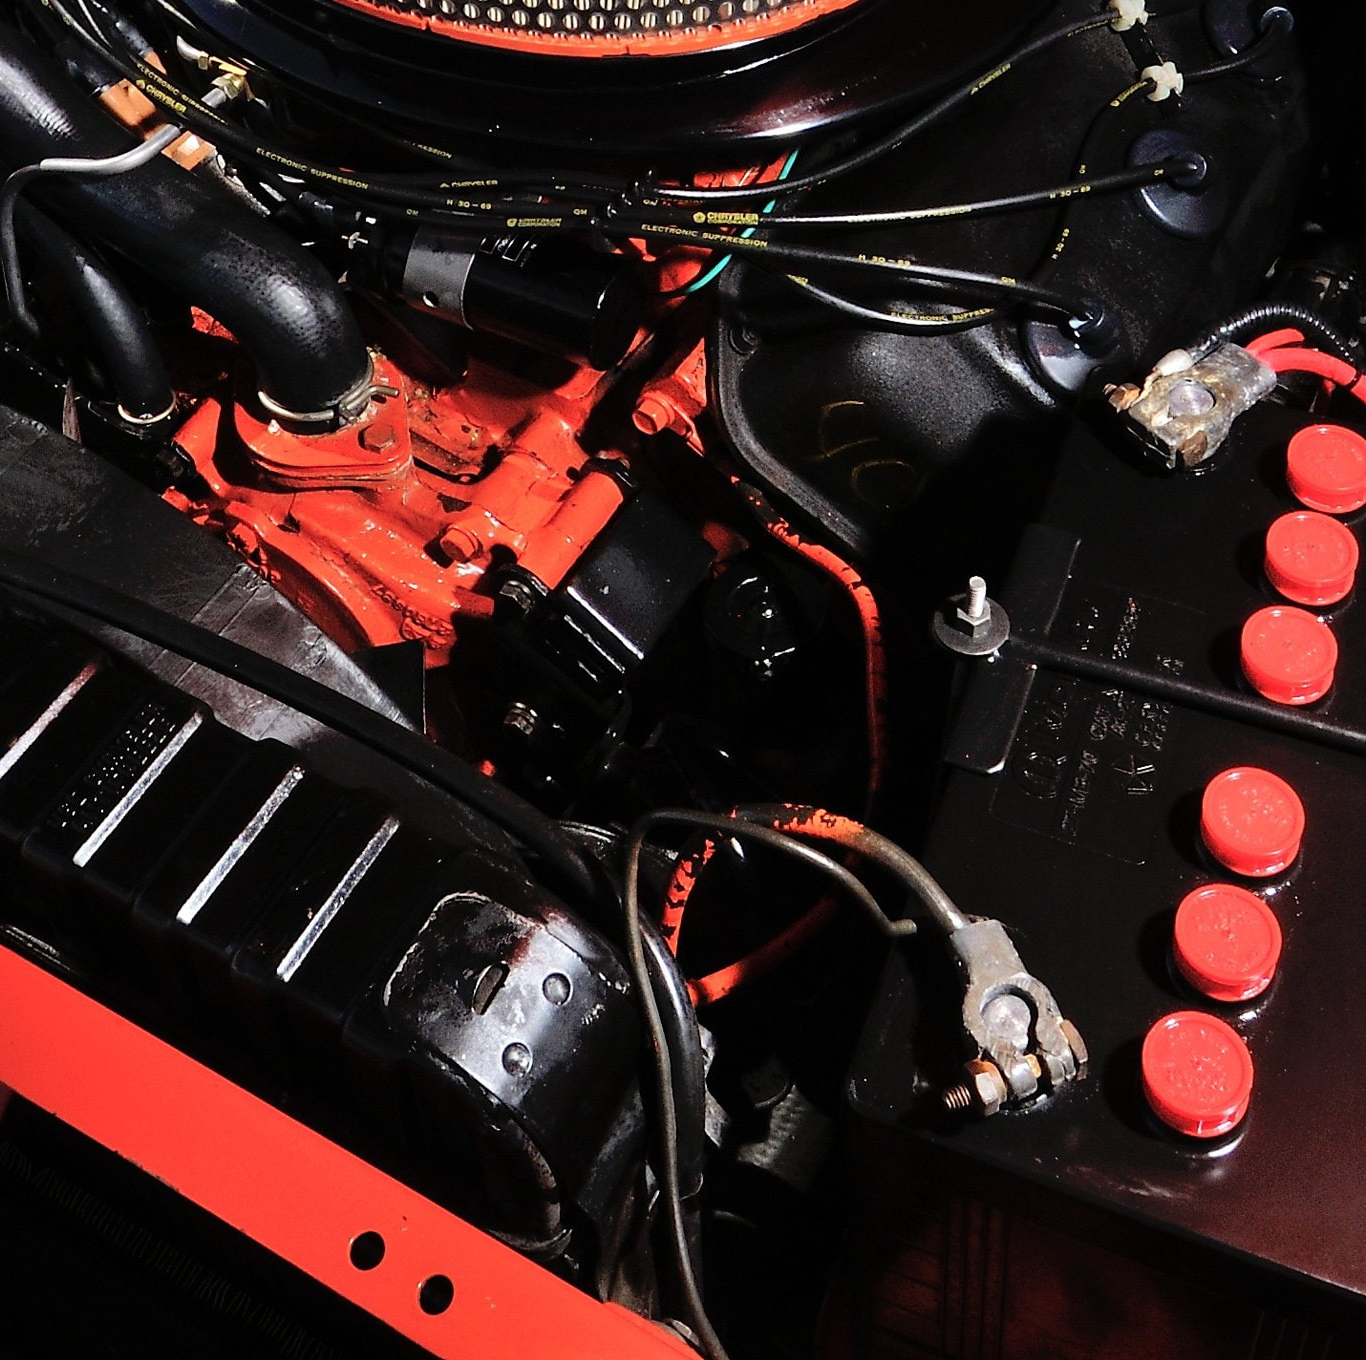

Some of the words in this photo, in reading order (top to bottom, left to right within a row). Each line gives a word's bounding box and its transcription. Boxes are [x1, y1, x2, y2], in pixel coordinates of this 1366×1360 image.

[137, 62, 180, 96] ELECTRONIC
[146, 84, 187, 113] CHRYSLER
[256, 147, 308, 172] ELECTRONIC
[310, 168, 370, 190] SUPPRESSION
[706, 211, 759, 221] CHRYSLER
[641, 224, 698, 237] ELECTRONIC
[702, 232, 768, 248] SUPPRESSION
